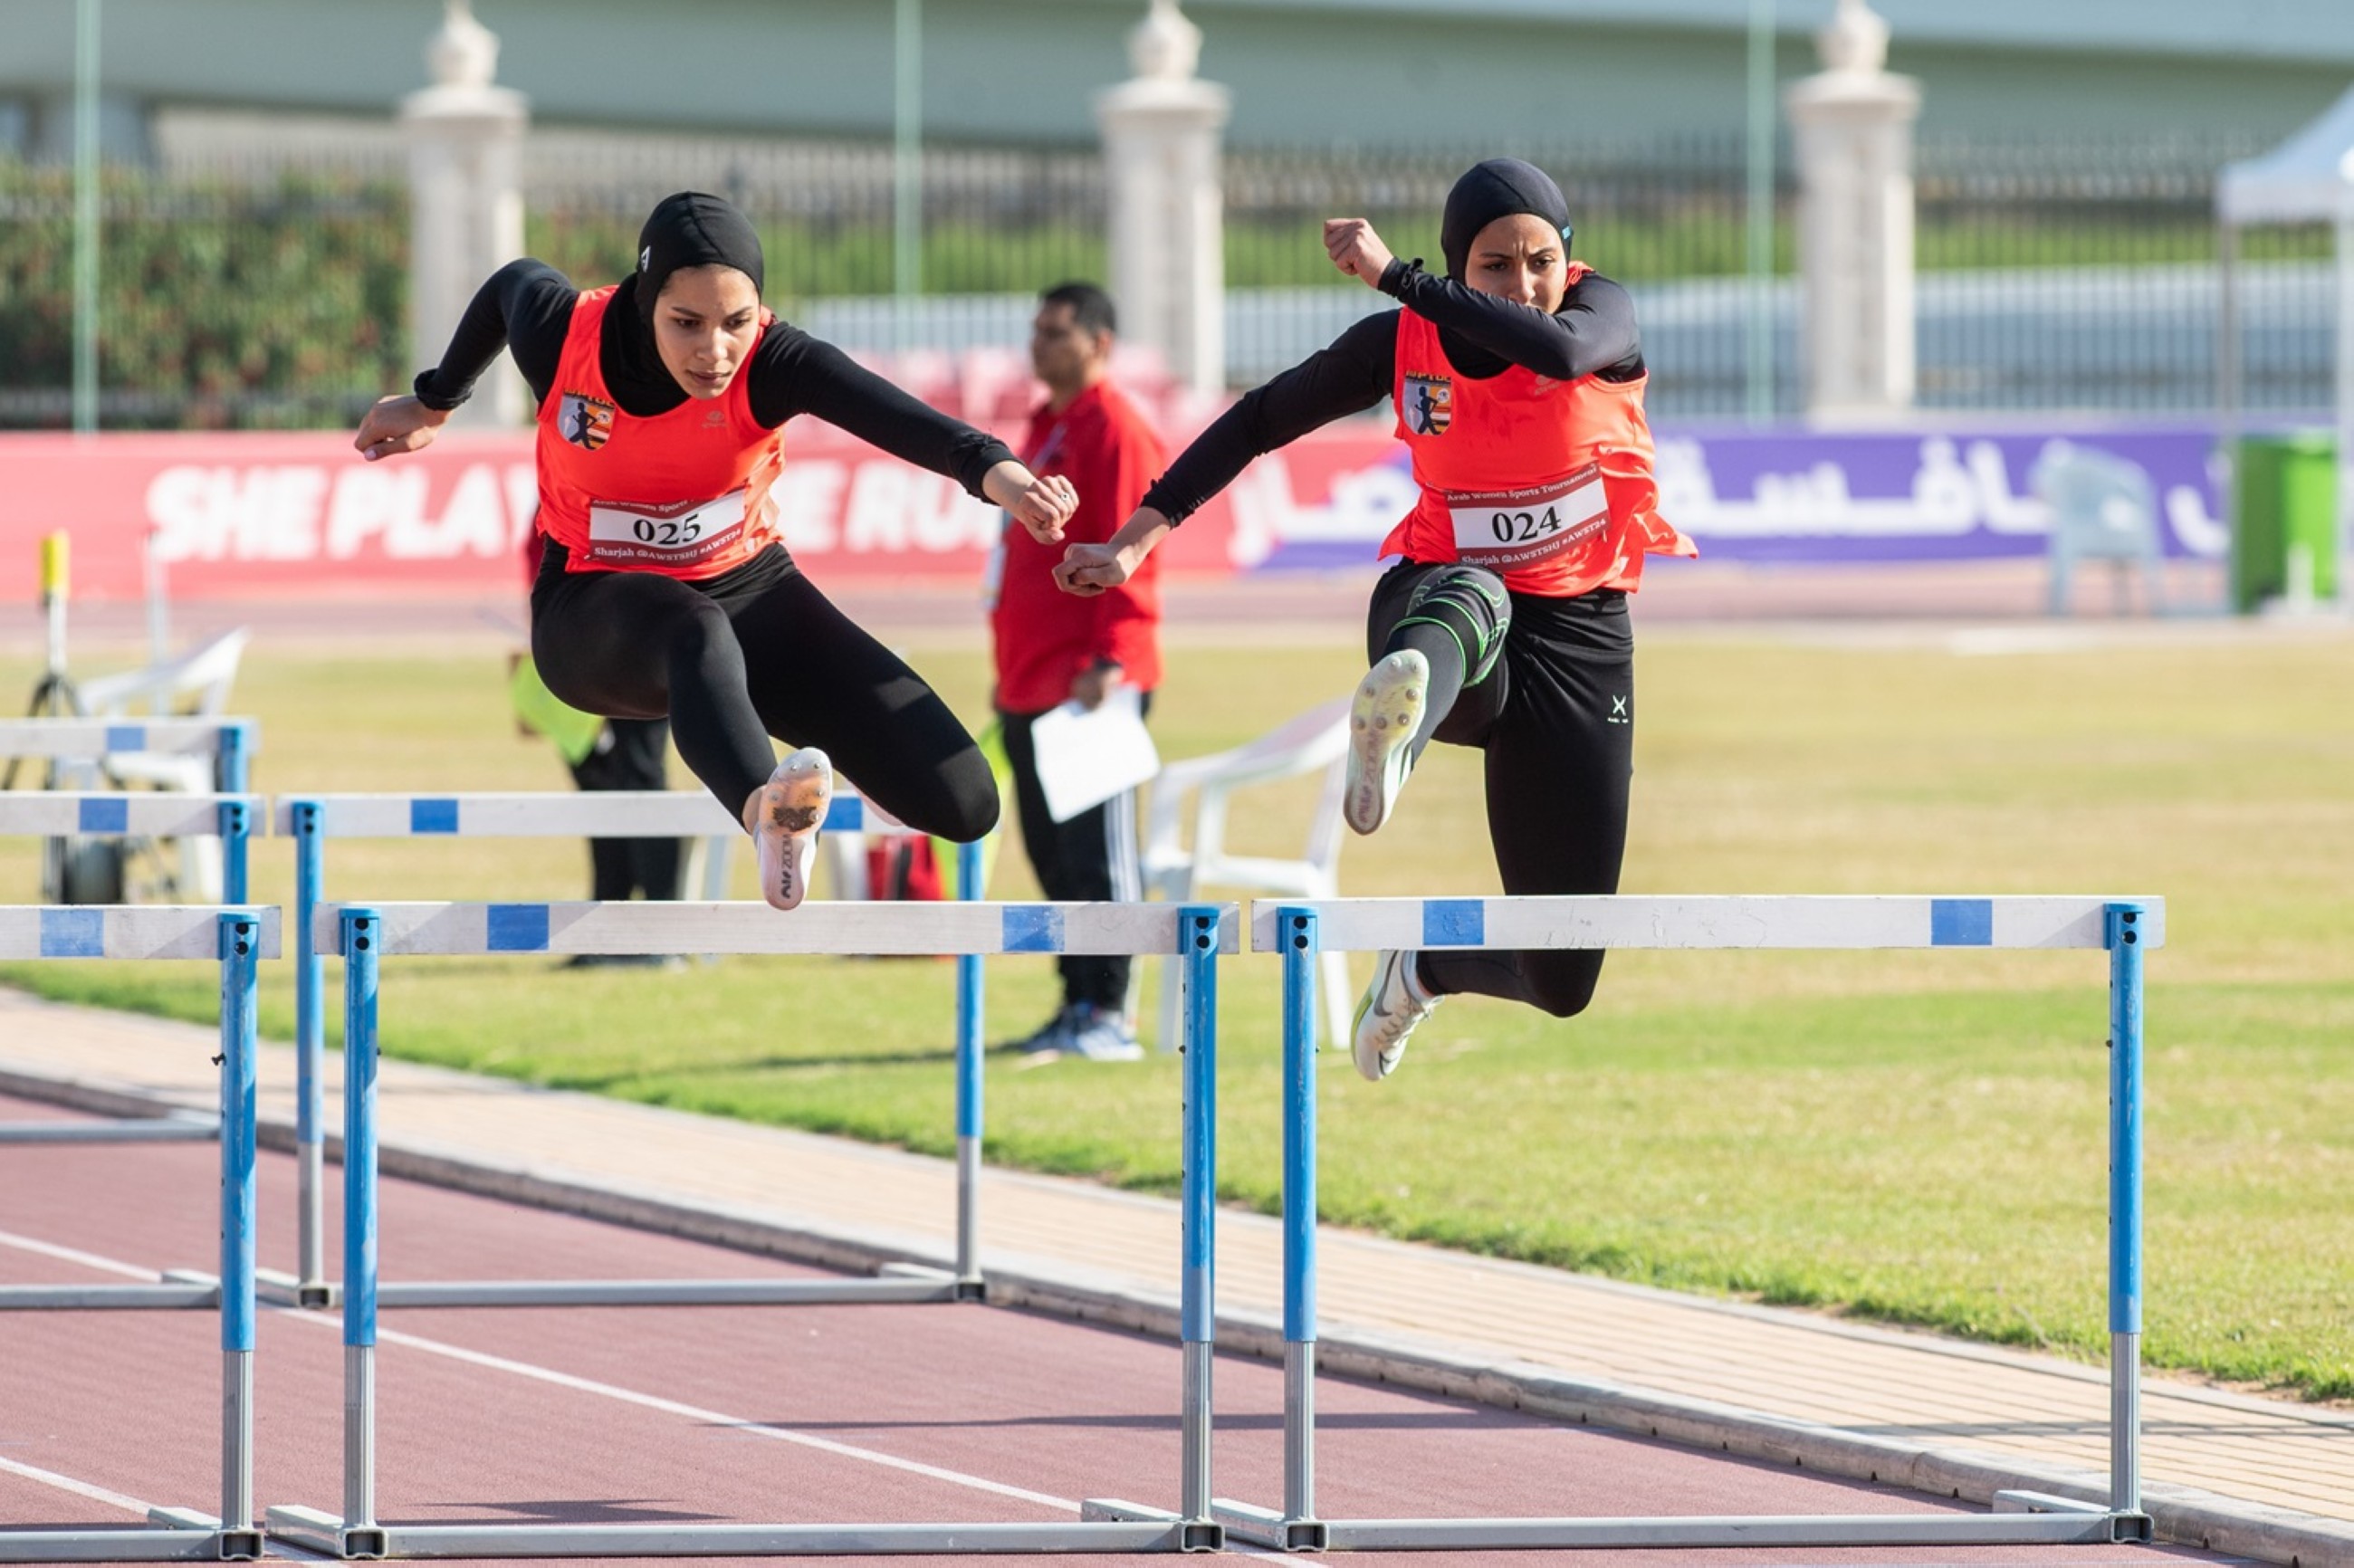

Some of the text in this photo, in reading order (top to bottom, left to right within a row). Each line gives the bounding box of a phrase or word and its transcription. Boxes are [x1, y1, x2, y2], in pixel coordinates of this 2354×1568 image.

[1448, 464, 1597, 501] Arab Women Sports Tournament
[146, 464, 330, 561] SHE
[633, 512, 701, 545] 025
[1492, 505, 1561, 542] 024
[593, 546, 635, 558] Sharjah
[1461, 555, 1499, 569] Sharjah
